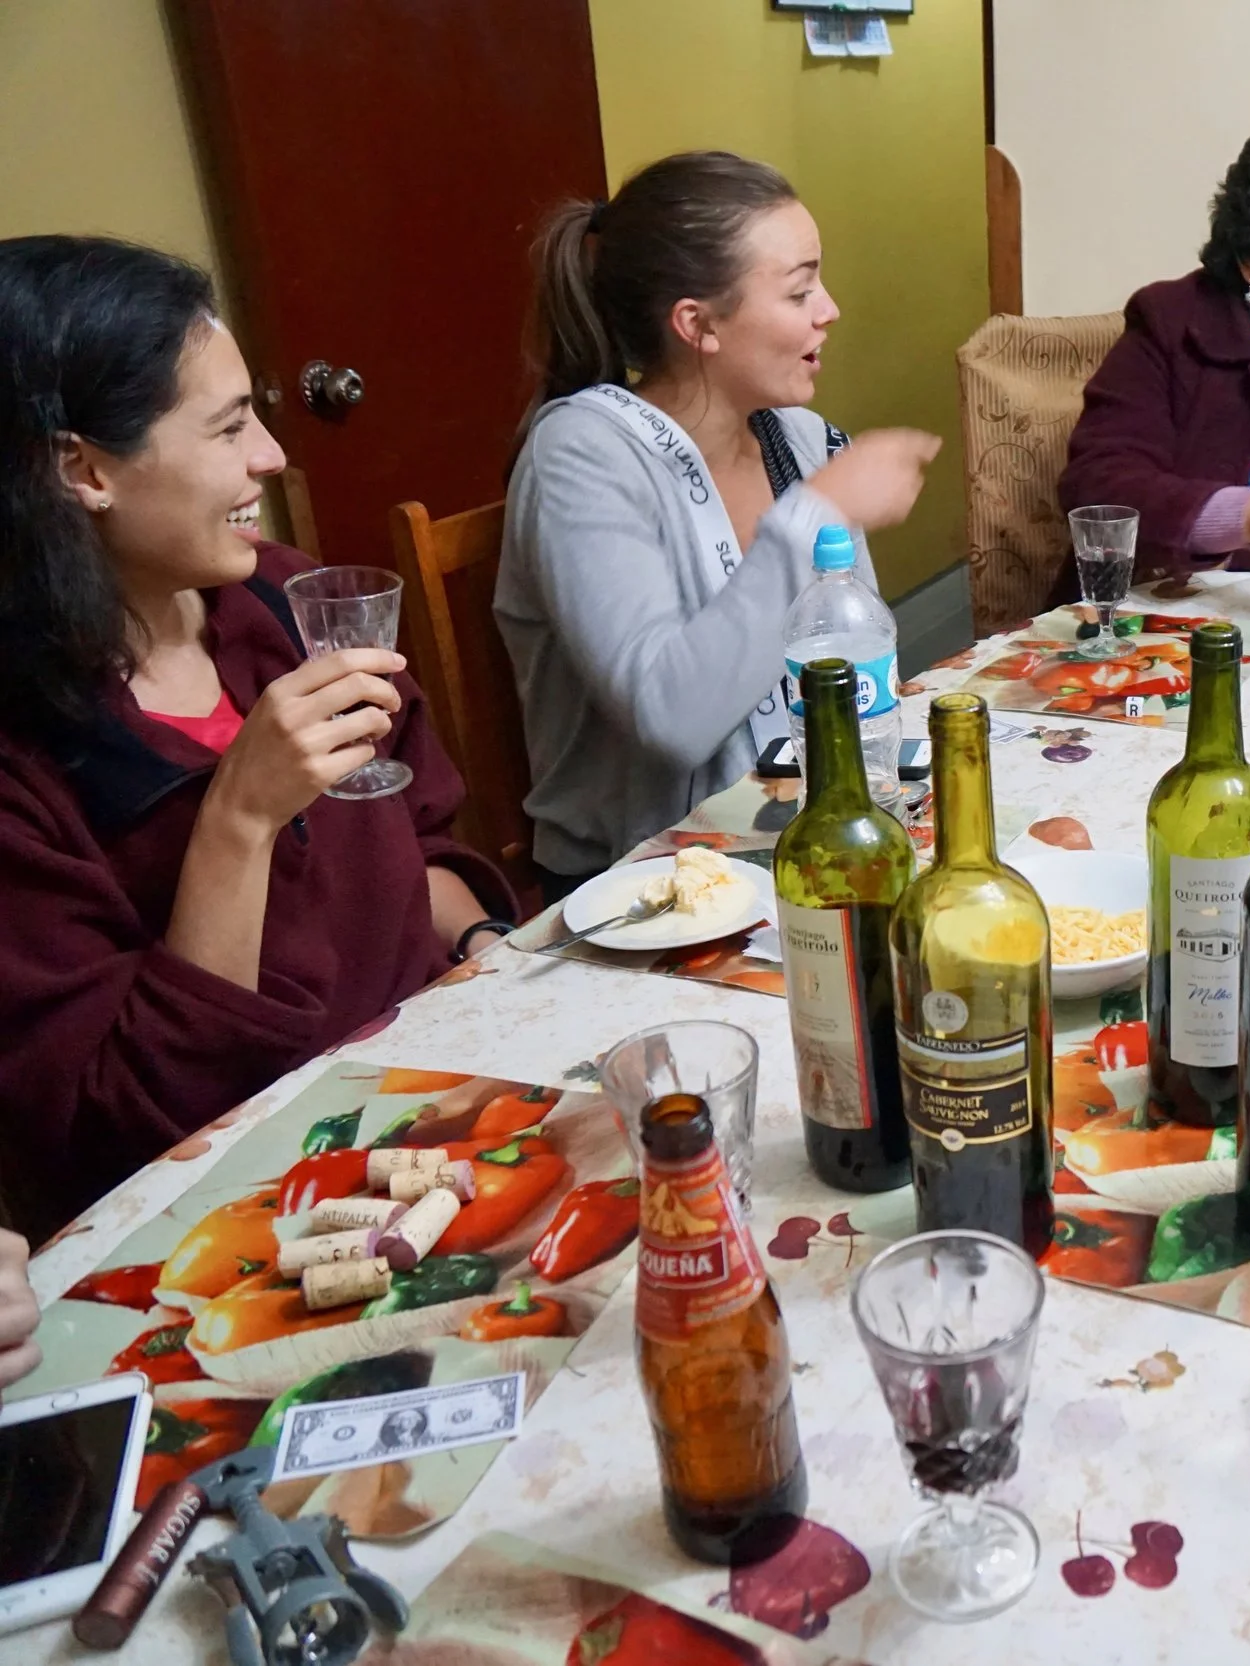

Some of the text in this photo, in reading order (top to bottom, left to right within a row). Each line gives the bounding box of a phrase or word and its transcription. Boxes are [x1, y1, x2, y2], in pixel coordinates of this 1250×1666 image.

[594, 385, 709, 505] Calvin Klein Jean
[716, 541, 735, 576] ans
[1130, 703, 1138, 716] R
[1187, 880, 1236, 889] SANTIAGO
[920, 1088, 984, 1109] CABERNET
[920, 1101, 989, 1121] SAUVIGNON
[321, 1210, 379, 1227] NTIPALKA
[643, 1250, 713, 1278] QUEÑA
[147, 1491, 201, 1563] SUGAR
